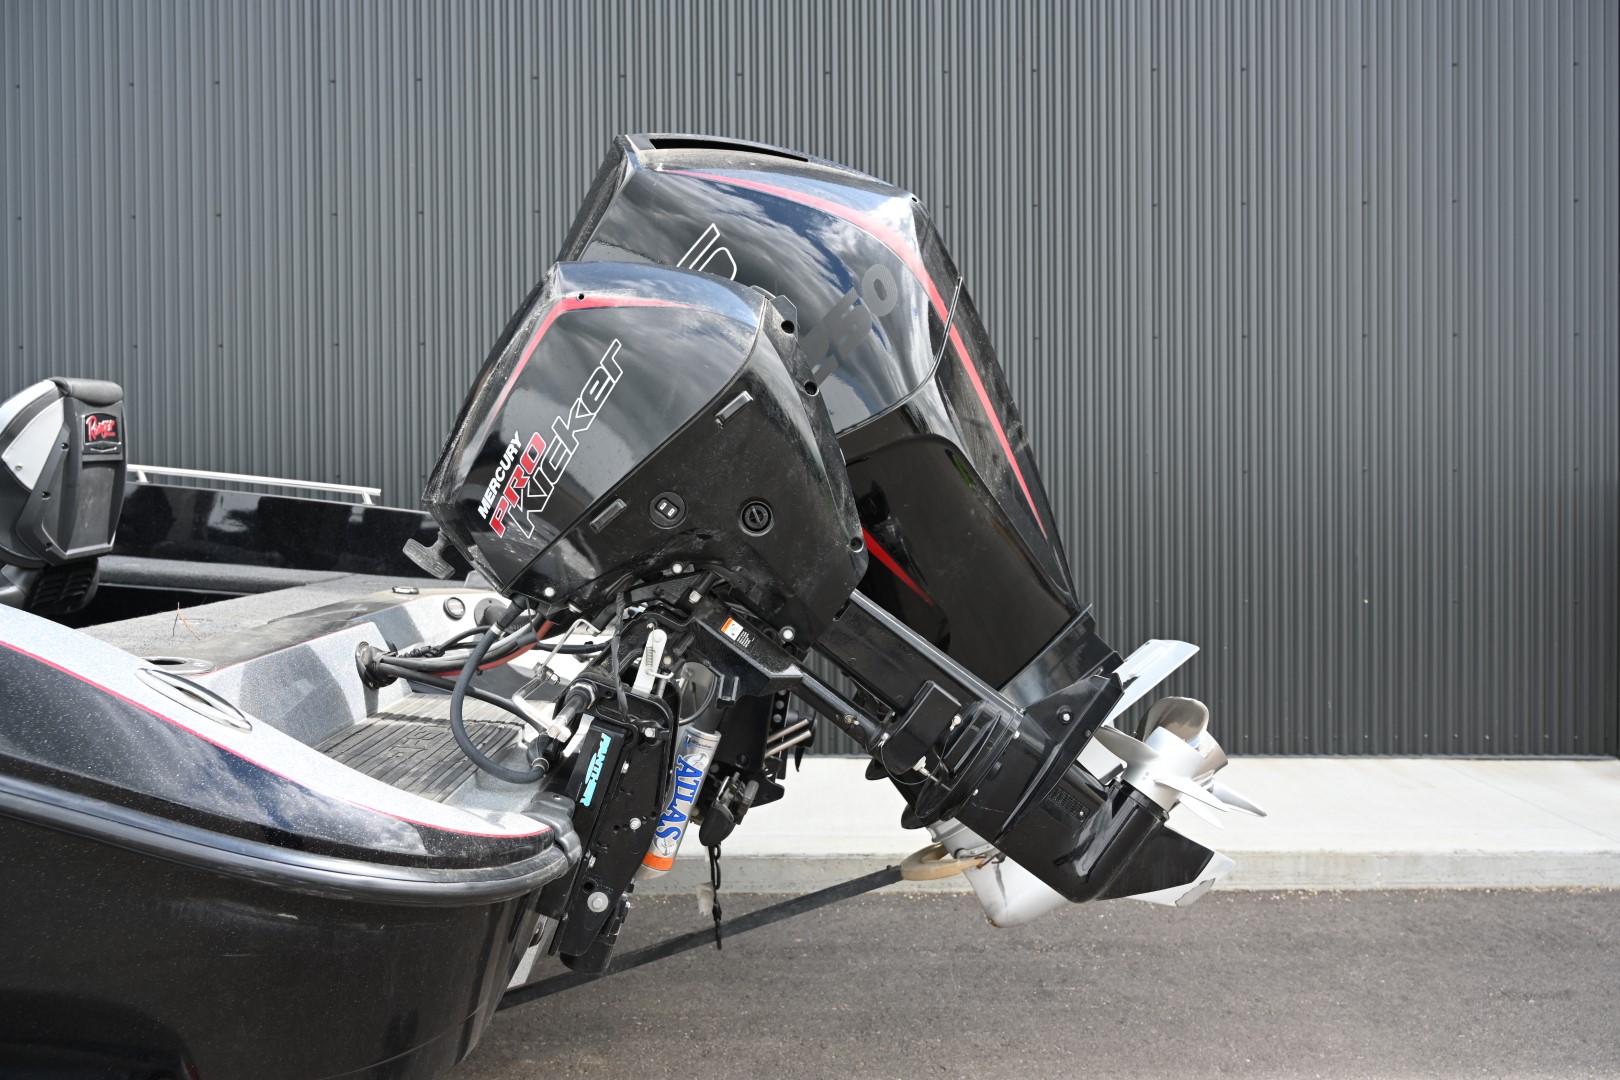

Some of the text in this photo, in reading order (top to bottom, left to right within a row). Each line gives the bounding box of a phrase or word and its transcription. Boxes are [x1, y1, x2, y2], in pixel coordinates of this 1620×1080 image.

[477, 430, 523, 520] MERCURY
[489, 431, 547, 538] PRO
[655, 754, 705, 841] ATLAS
